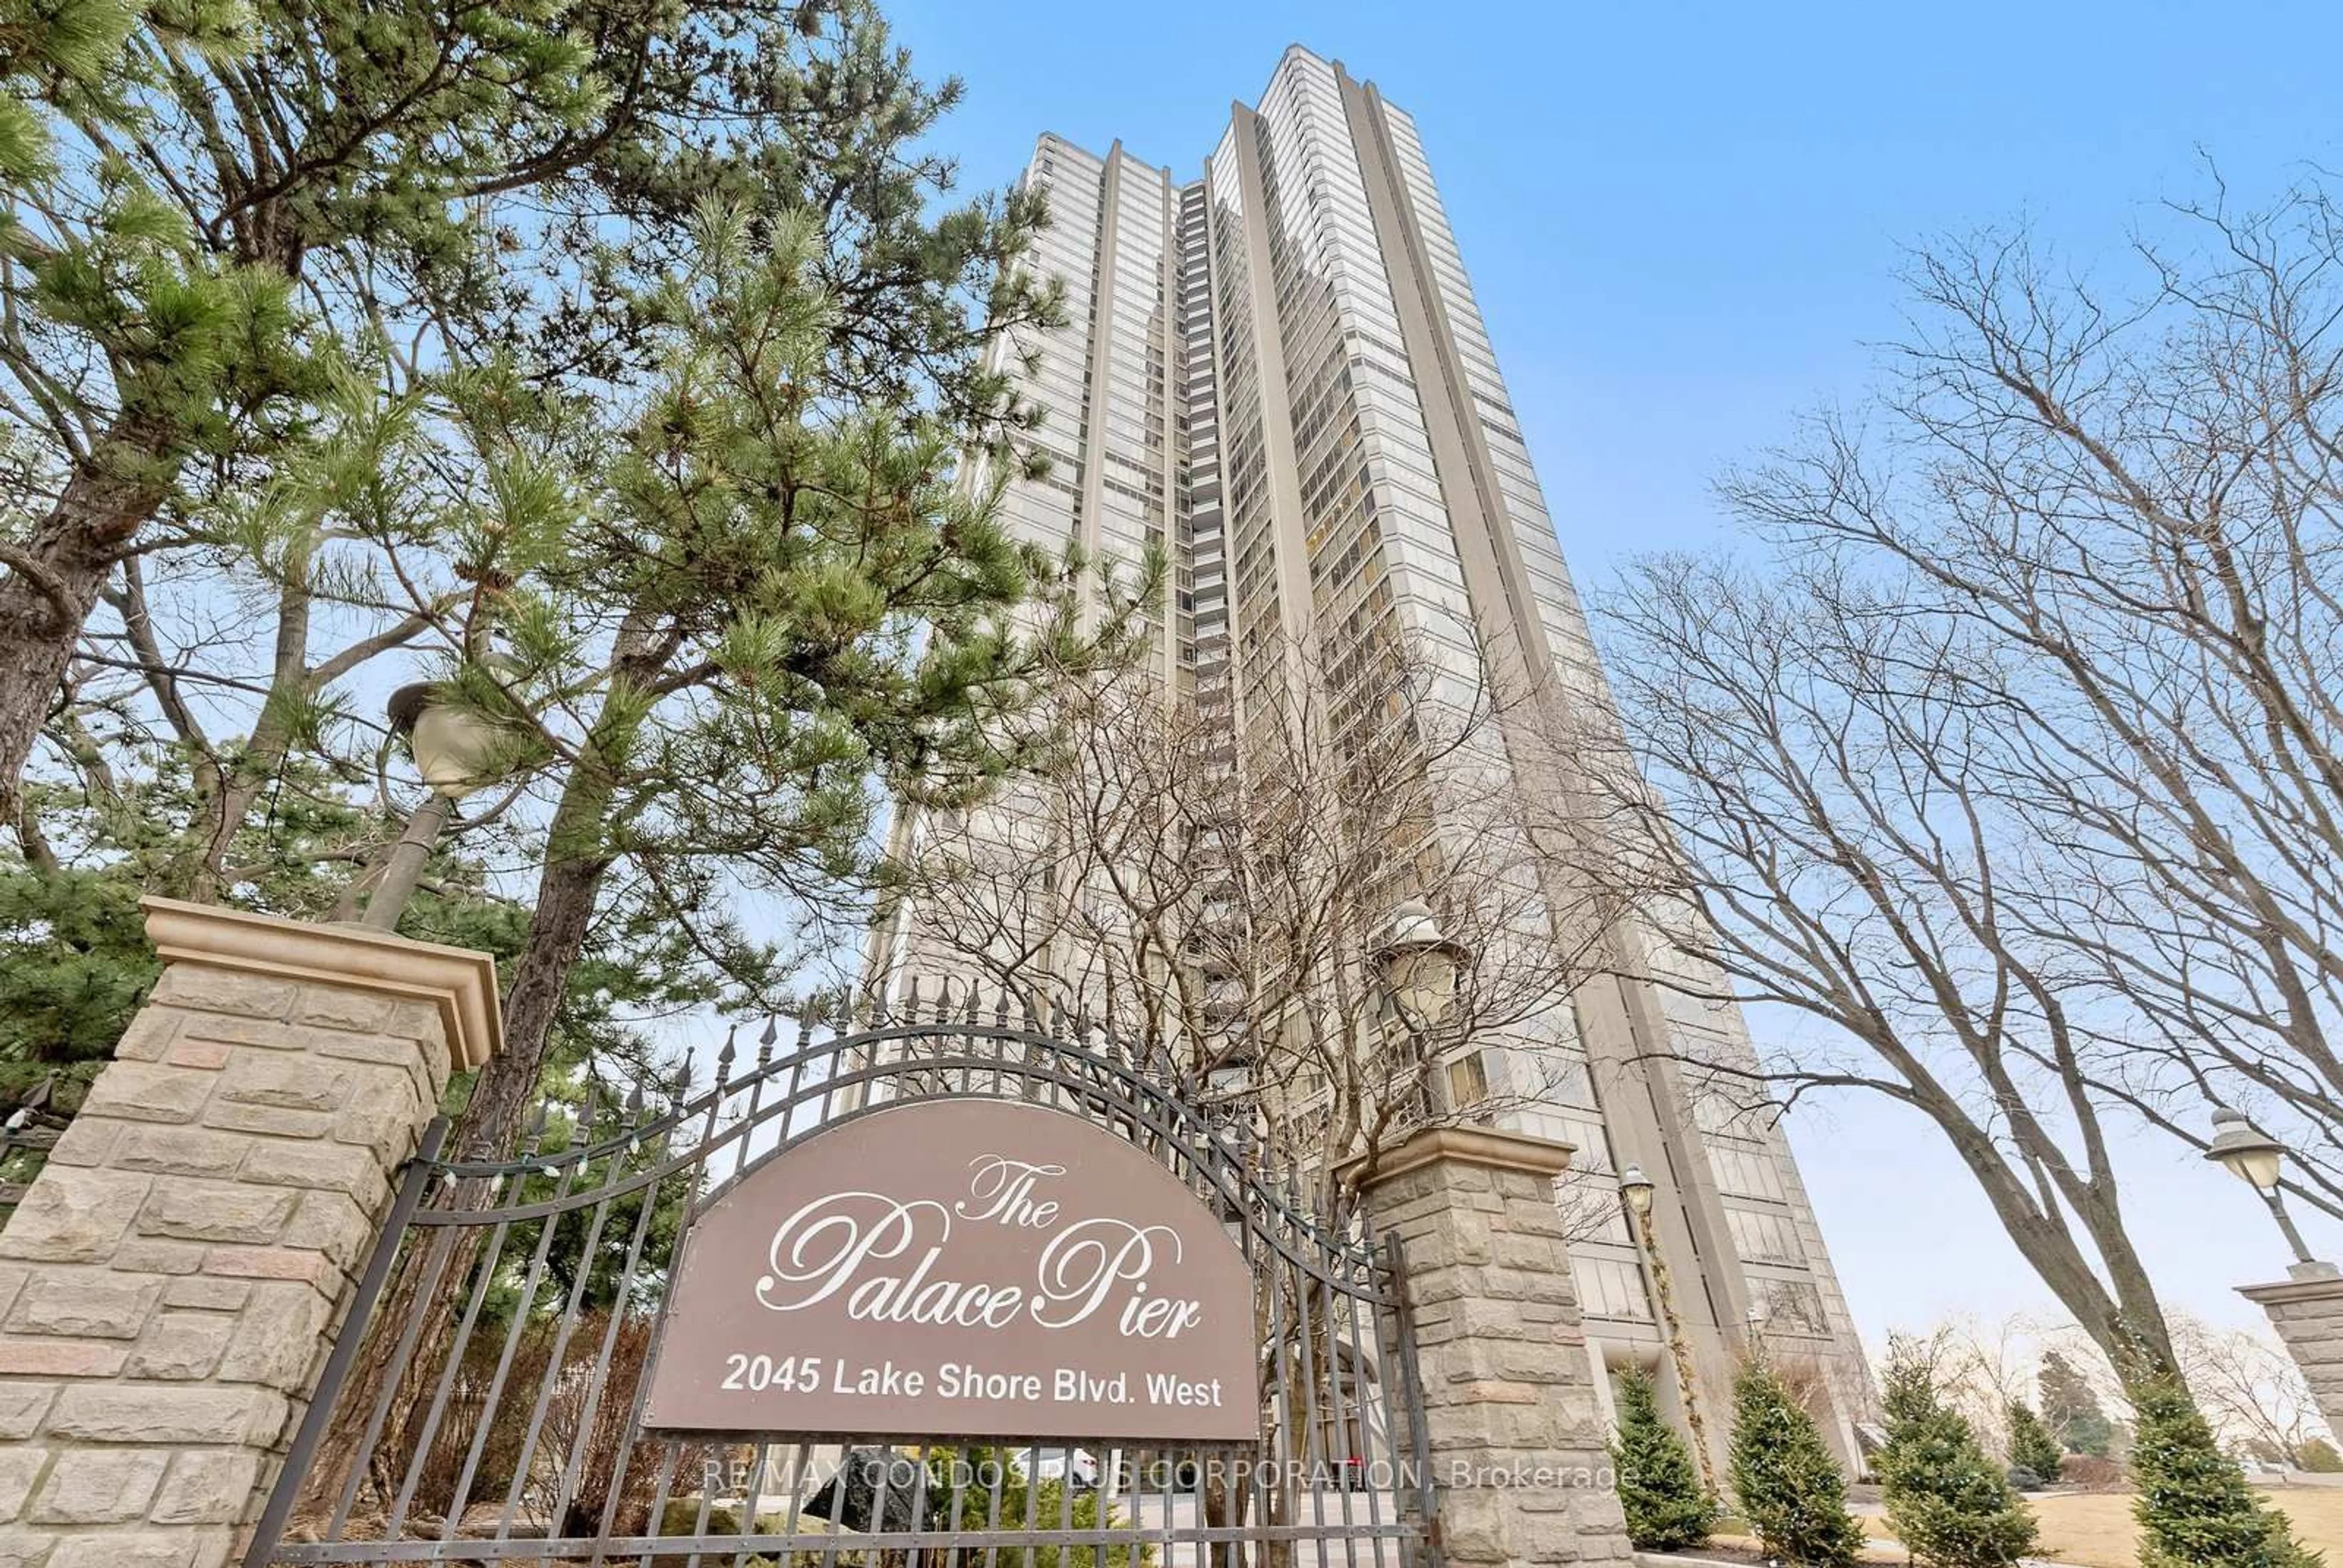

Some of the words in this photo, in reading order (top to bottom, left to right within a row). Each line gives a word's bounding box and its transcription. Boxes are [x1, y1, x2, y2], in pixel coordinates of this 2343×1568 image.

[956, 1153, 1067, 1229] The
[755, 1191, 1023, 1328] Palace
[1030, 1218, 1201, 1339] Pier
[721, 1354, 821, 1394] 2045
[833, 1361, 925, 1397] Lake
[936, 1362, 1042, 1400] Shore
[1053, 1368, 1136, 1404] Blvd.
[1146, 1373, 1222, 1407] West
